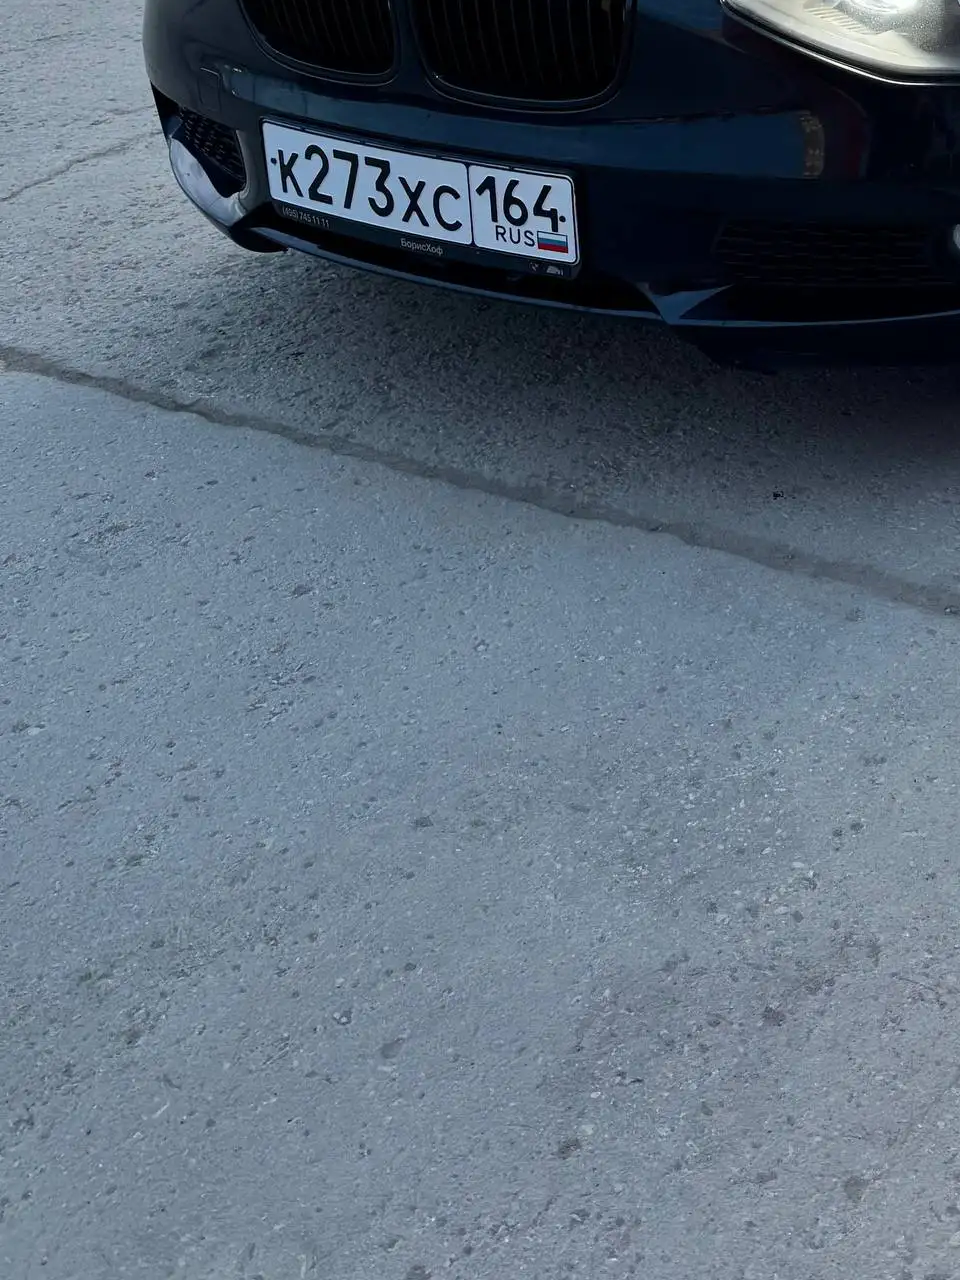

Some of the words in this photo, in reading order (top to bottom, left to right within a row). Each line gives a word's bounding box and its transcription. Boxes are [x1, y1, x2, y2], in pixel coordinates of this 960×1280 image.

[277, 144, 463, 232] К273ХС
[475, 175, 560, 233] 164
[400, 237, 444, 257] БорисХоф
[495, 225, 536, 247] RUS
